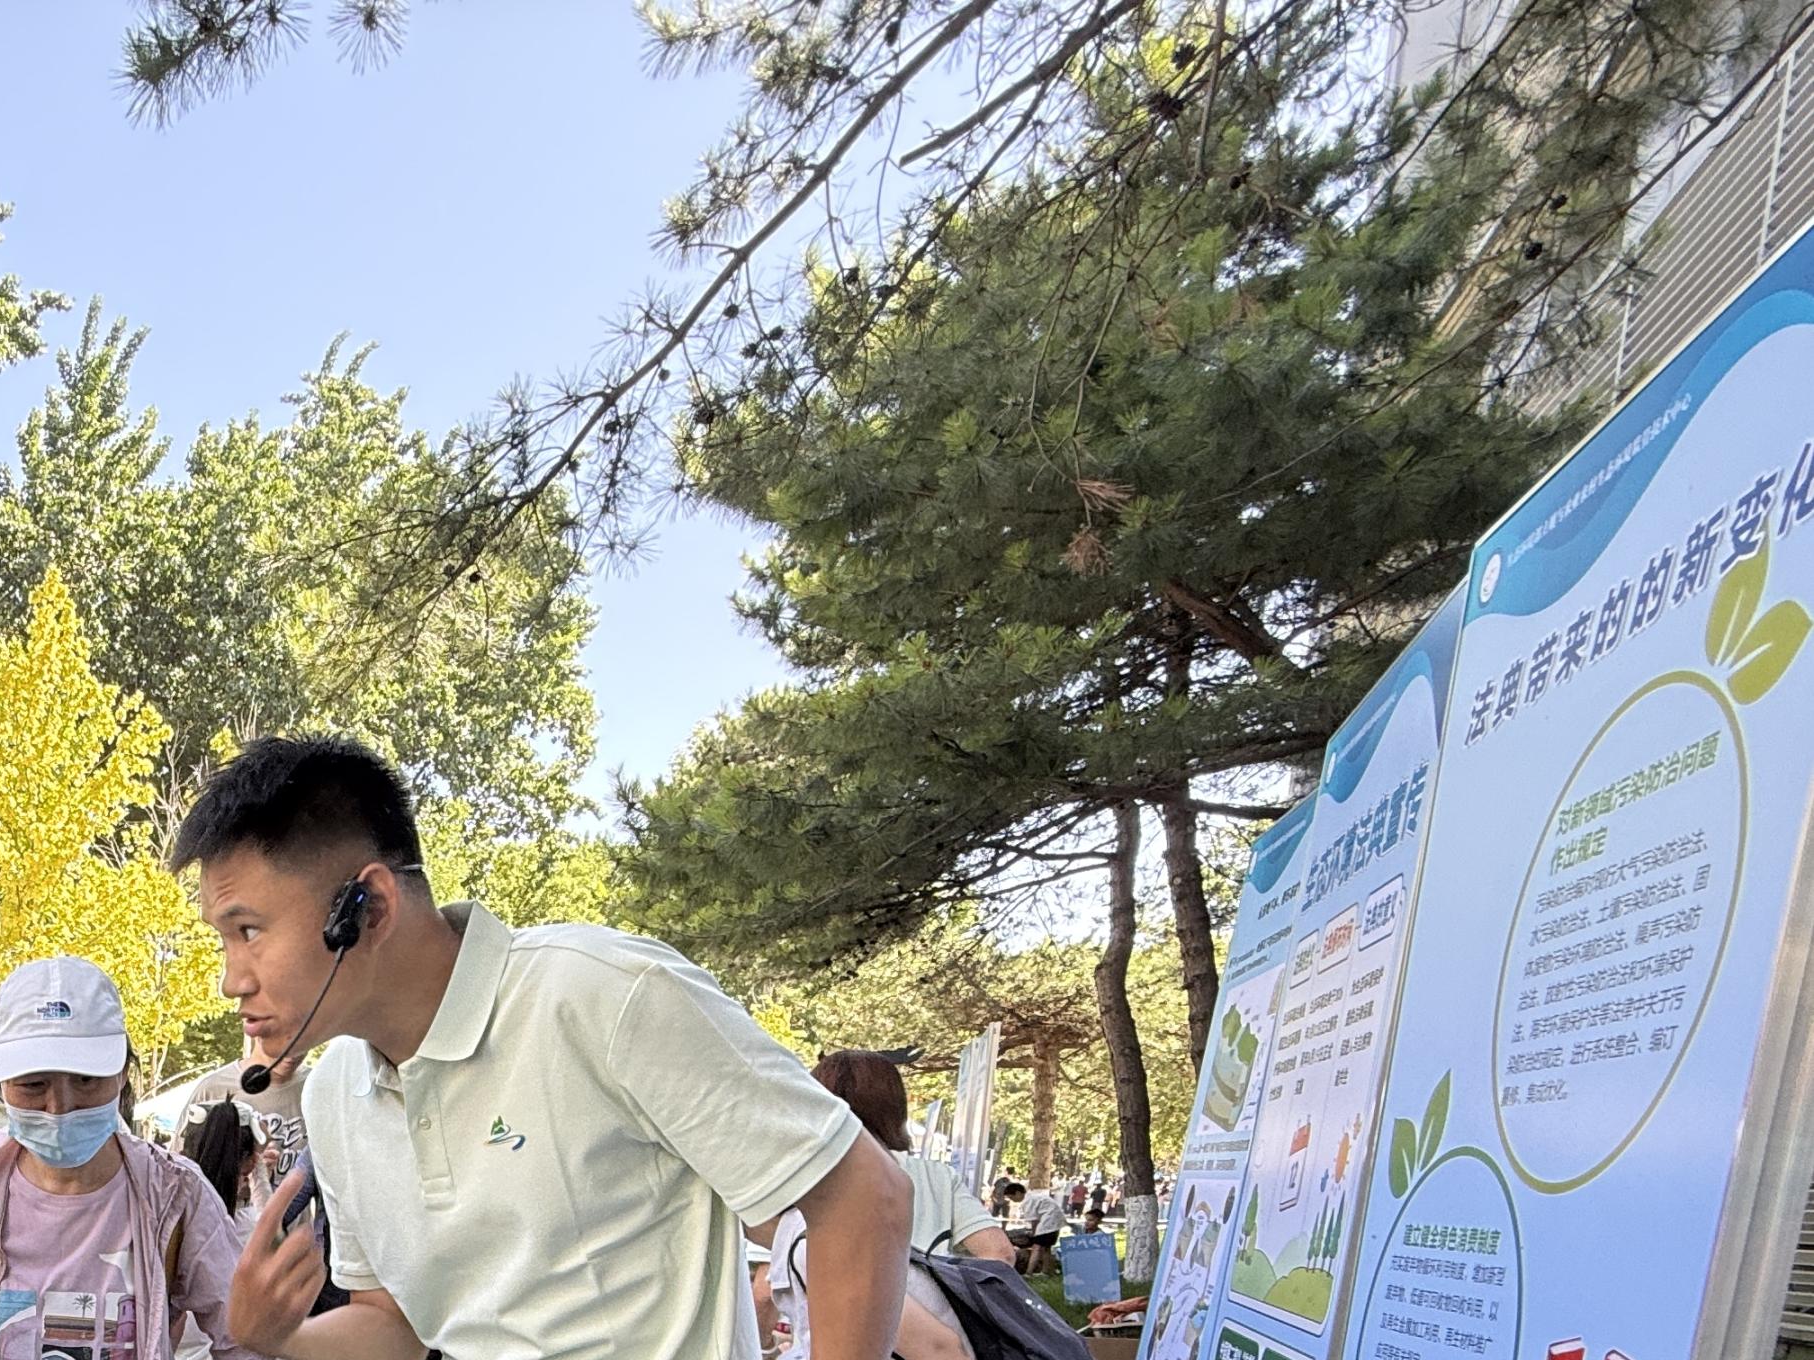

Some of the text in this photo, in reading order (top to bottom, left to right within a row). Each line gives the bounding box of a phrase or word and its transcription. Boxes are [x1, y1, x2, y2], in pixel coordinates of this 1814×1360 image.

[1463, 434, 1814, 747] 法典带来的的新变化
[1549, 824, 1608, 875] 作出规定
[1403, 1224, 1501, 1255] 建立健全绿色消费制度
